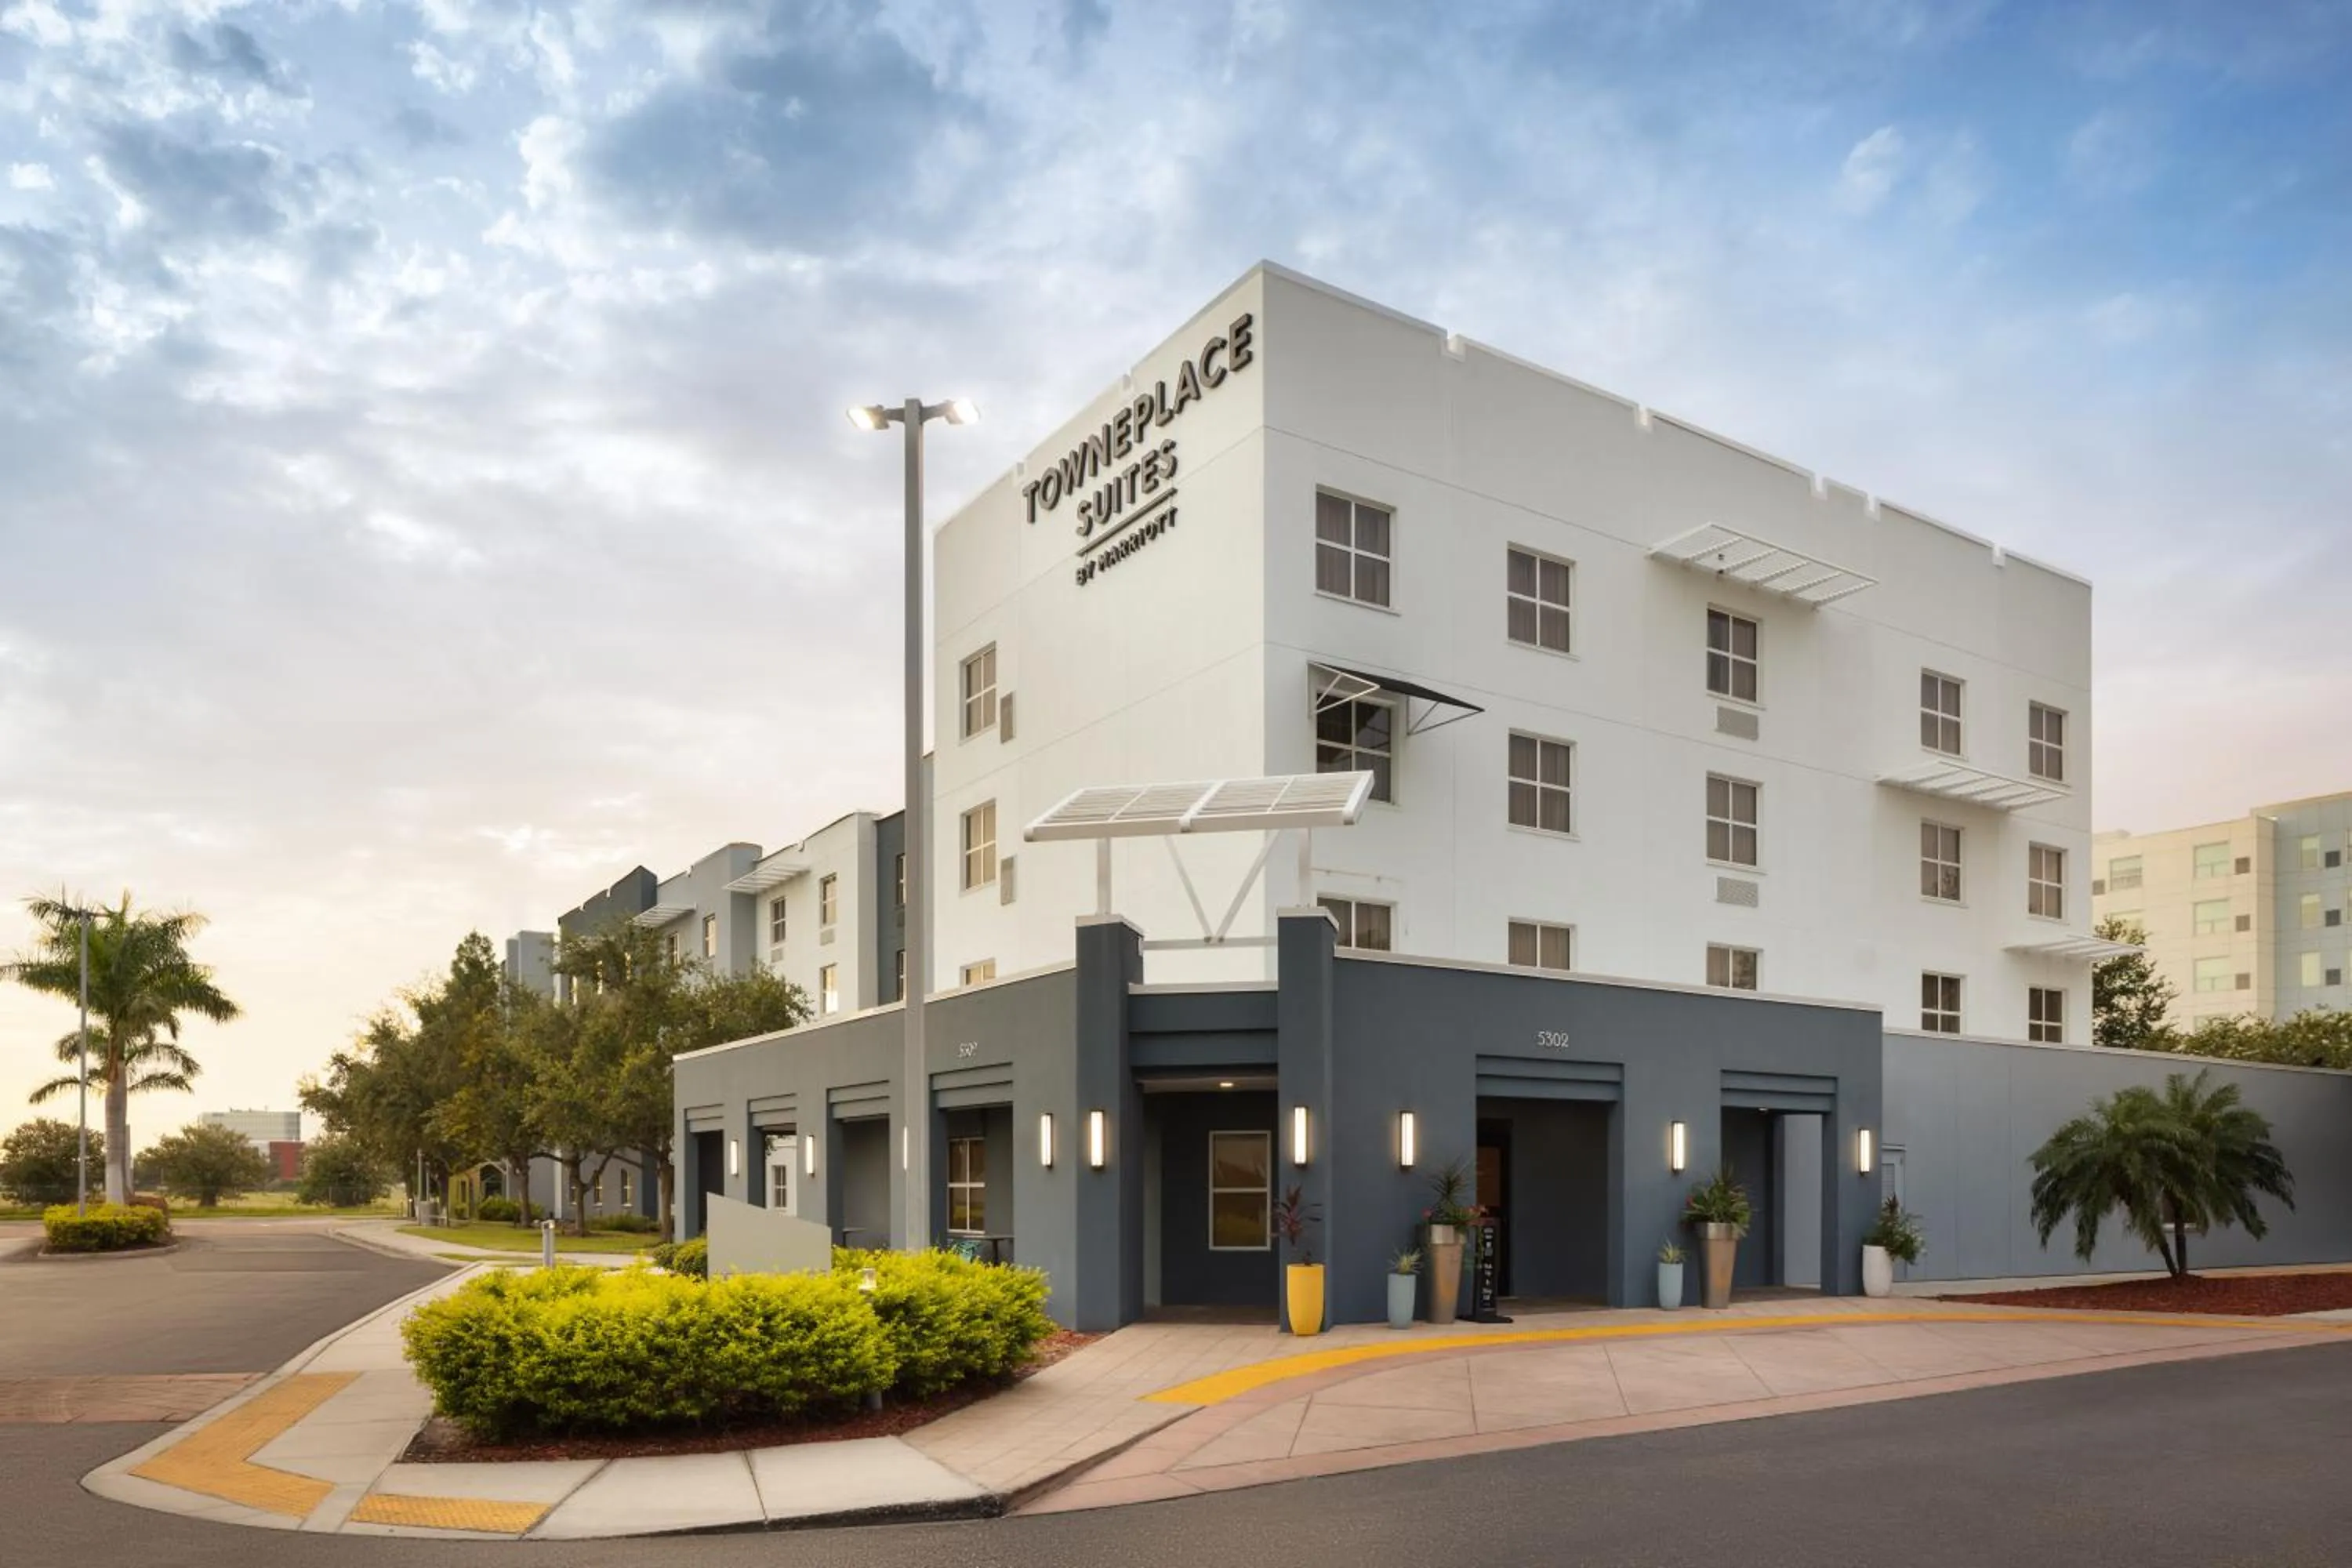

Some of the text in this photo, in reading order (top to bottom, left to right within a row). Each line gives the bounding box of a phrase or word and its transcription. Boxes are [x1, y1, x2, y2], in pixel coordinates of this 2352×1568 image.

[1022, 313, 1253, 524] TOWNEPLACE
[1076, 438, 1178, 537] SUITES
[1076, 507, 1178, 586] BY MARRIOTT
[1537, 1031, 1569, 1048] 5302
